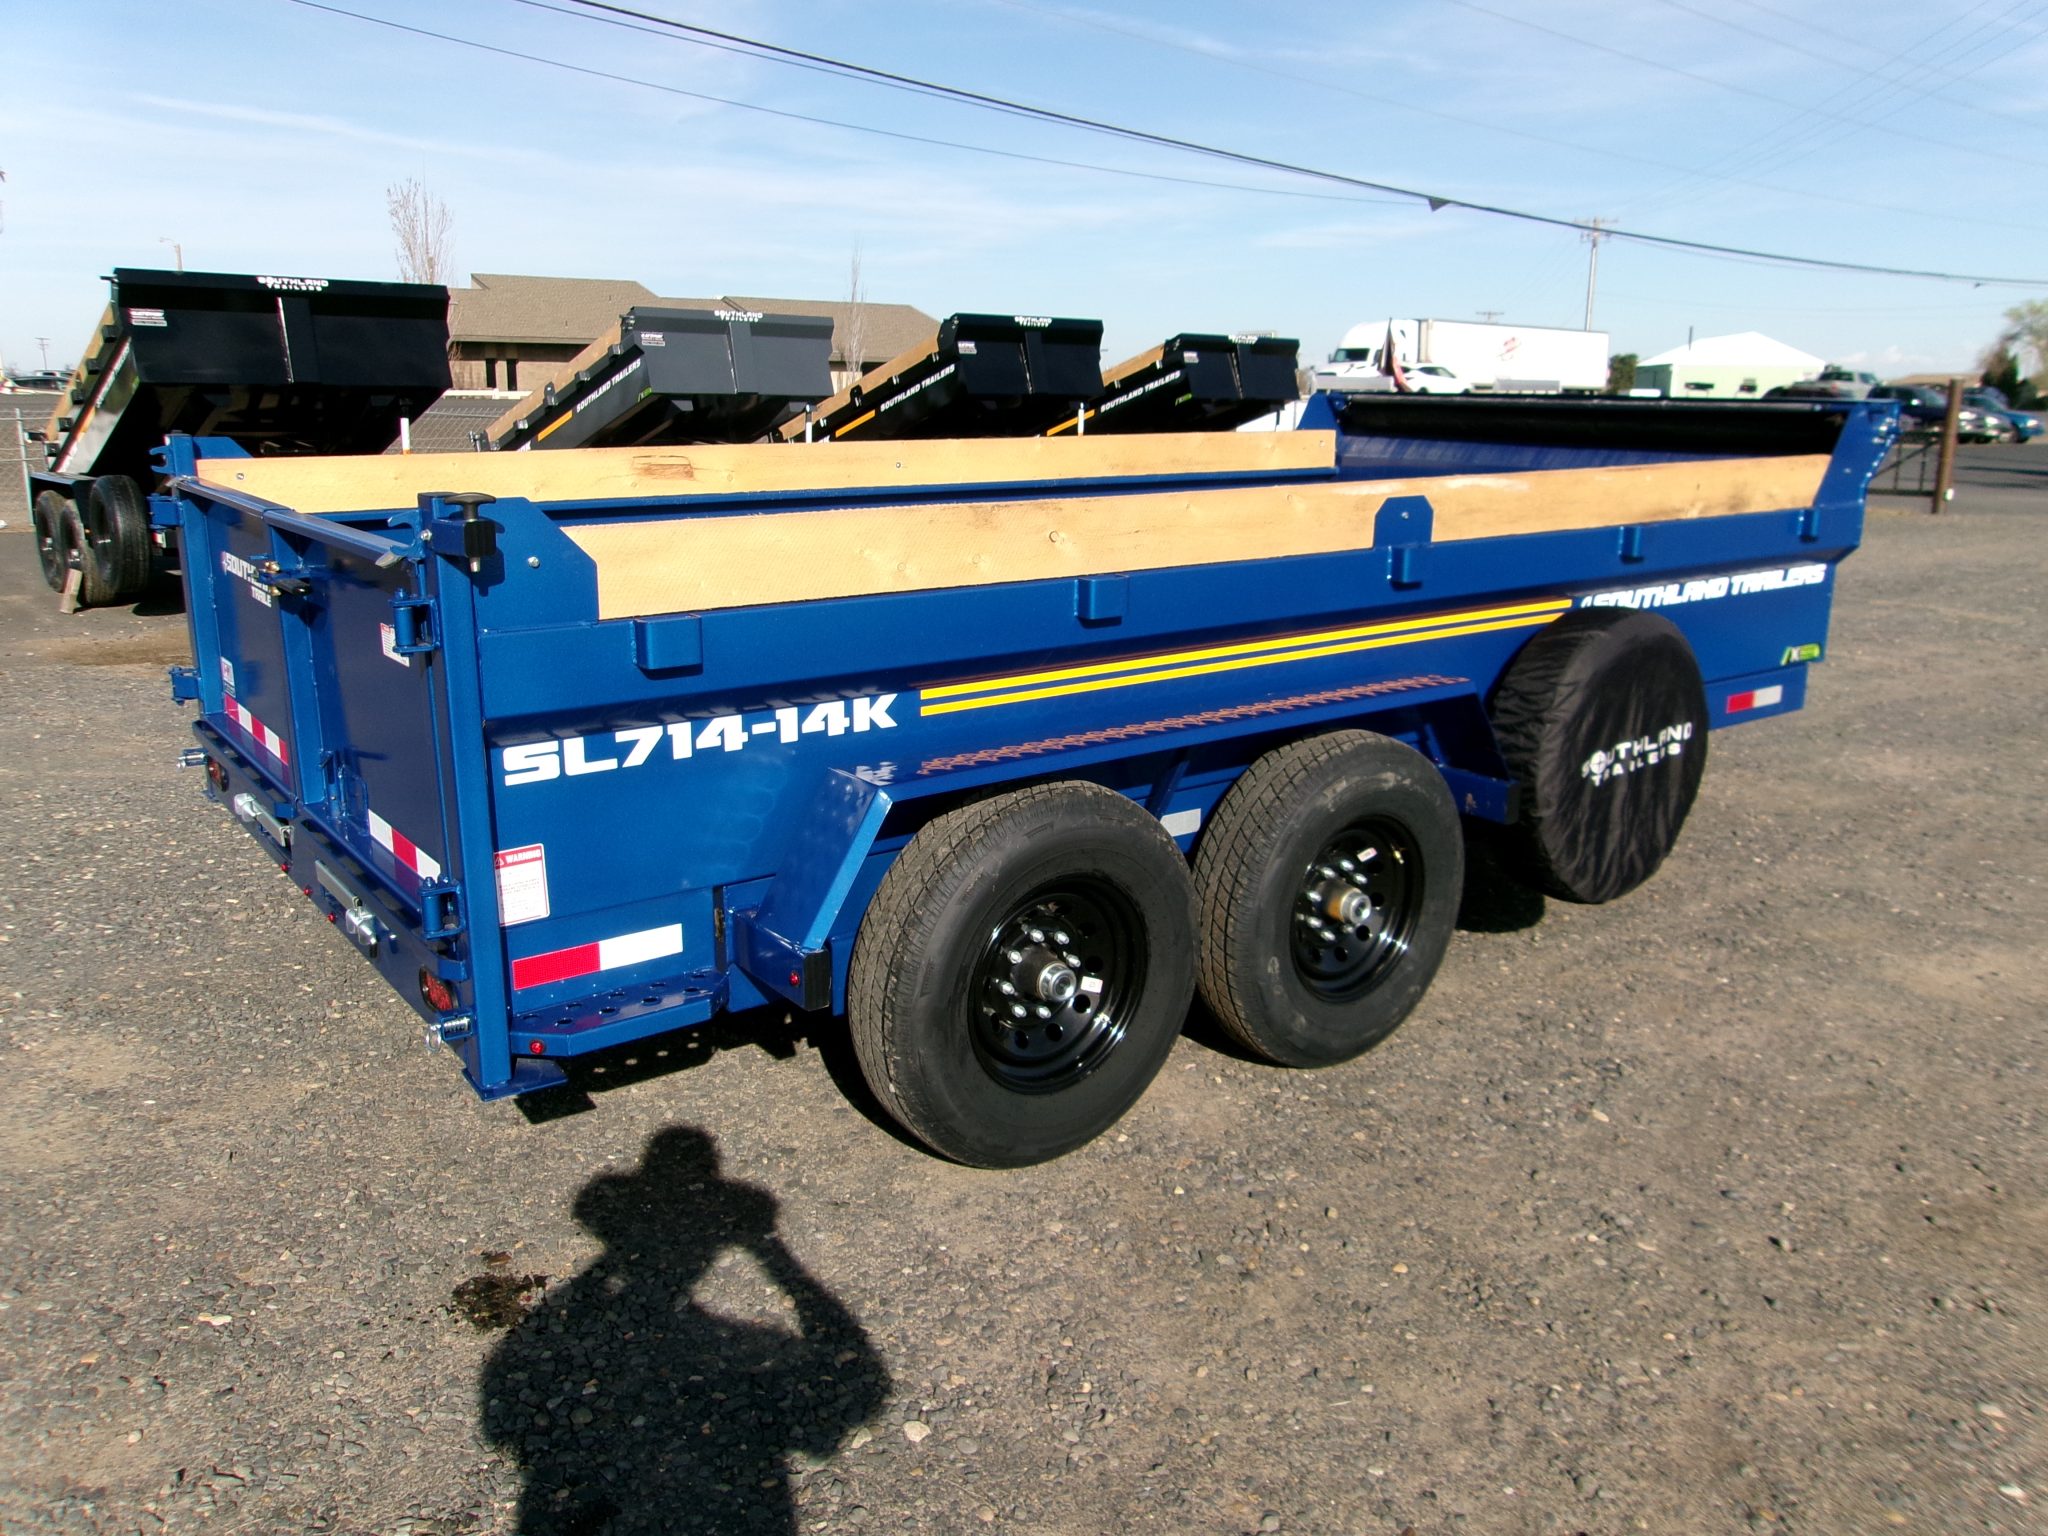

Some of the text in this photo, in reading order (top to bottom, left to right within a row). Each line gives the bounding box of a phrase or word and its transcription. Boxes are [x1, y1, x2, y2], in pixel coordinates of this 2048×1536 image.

[256, 276, 329, 287] SOUTHLAND
[576, 381, 612, 413] SOUTHLAND
[611, 358, 642, 387] TRAILERS
[880, 363, 956, 412] SOUTHLAND TRAILERS
[1100, 370, 1181, 413] SOUTHLAND TRAILERS
[1730, 563, 1827, 596] TRAILERS
[503, 693, 899, 786] SL714-14K
[505, 848, 542, 864] WARNING
